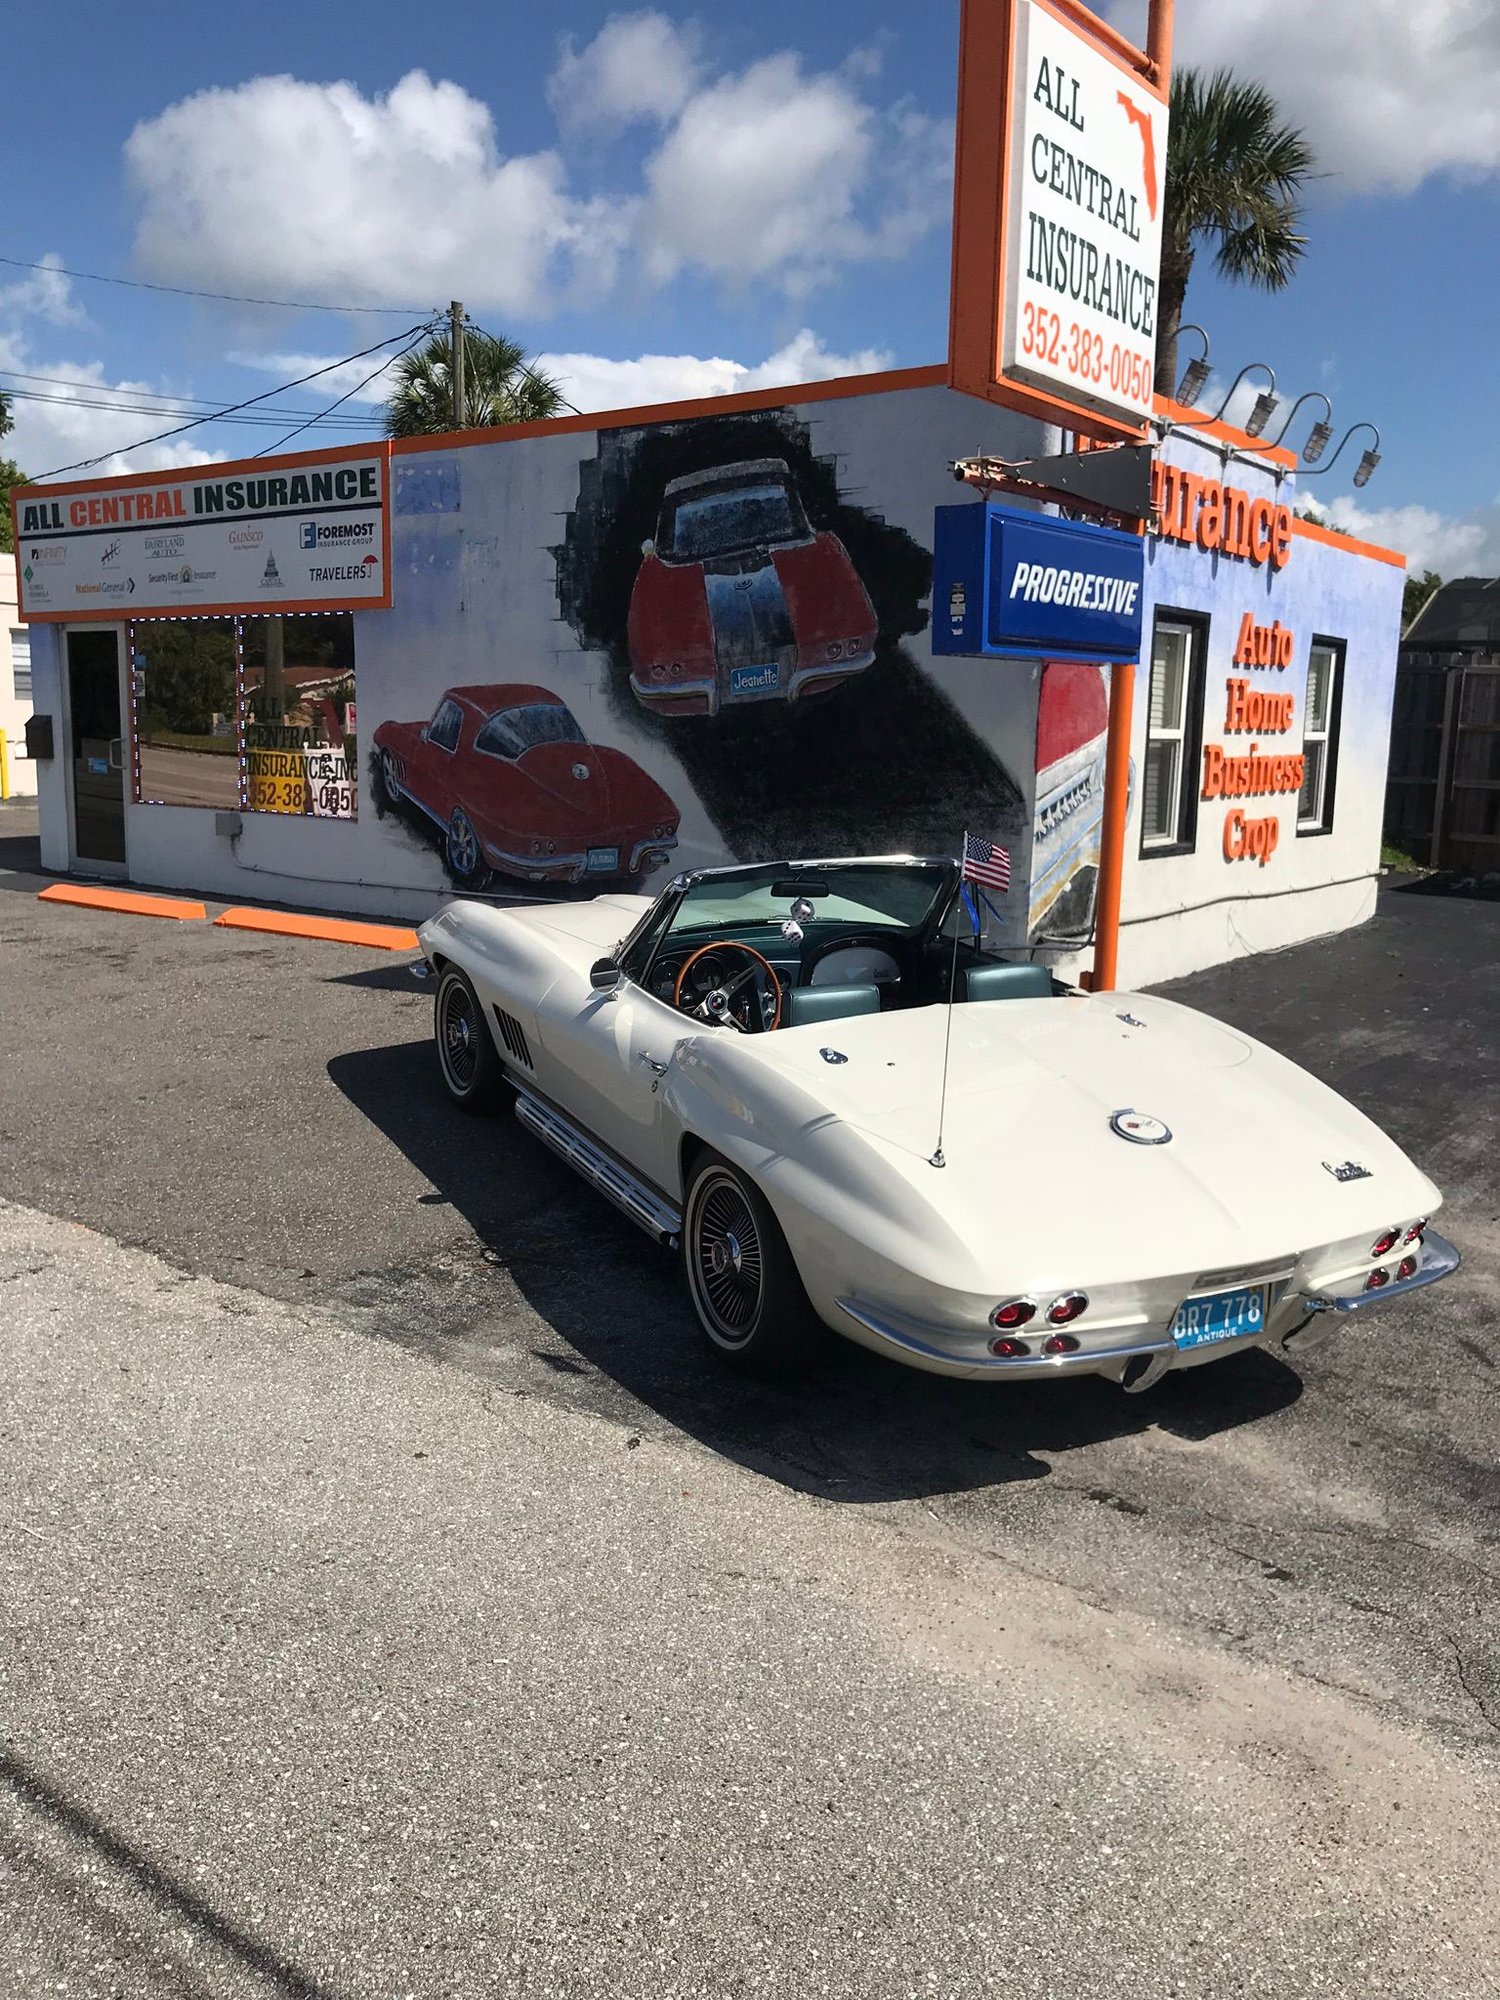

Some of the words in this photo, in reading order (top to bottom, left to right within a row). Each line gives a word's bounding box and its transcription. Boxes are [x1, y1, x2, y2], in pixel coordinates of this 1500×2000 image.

[1033, 56, 1085, 133] ALL
[1031, 133, 1140, 243] CENTRAL
[1026, 211, 1156, 338] INSURANCE
[1022, 301, 1152, 405] 352-383-0050
[24, 503, 64, 531] ALL
[69, 490, 187, 528] CENTRAL
[193, 467, 377, 514] INSURANCE
[1149, 460, 1293, 568] urance
[145, 538, 184, 551] DAIRYLAND
[317, 523, 374, 540] FOREMOST
[317, 540, 351, 548] INSURANCE
[352, 538, 373, 546] GROUP
[309, 565, 366, 582] TRAVELERS
[1009, 562, 1140, 616] PROGRESSIVE
[1232, 612, 1294, 667] Auto
[734, 669, 777, 689] Jeanette
[1224, 678, 1294, 731] Home
[1202, 743, 1306, 797] Business
[1223, 809, 1279, 863] Crop
[1174, 1303, 1213, 1340] BR7
[1221, 1294, 1261, 1328] 778
[1196, 1326, 1238, 1343] ANTIQUE
